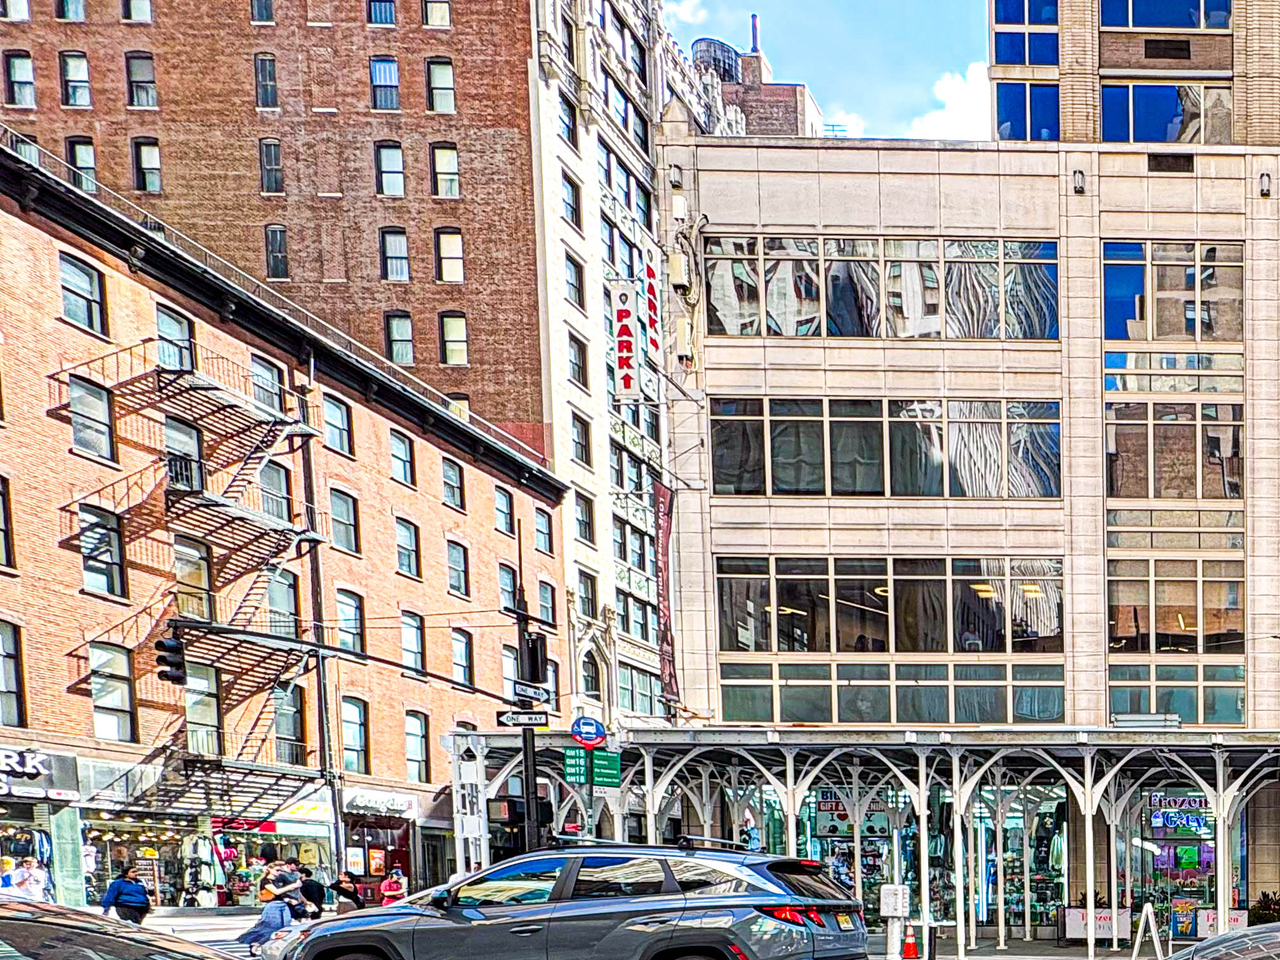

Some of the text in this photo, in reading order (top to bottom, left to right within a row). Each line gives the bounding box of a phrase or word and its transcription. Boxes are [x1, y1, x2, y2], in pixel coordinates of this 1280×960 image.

[616, 308, 635, 370] PARK
[506, 715, 520, 723] ONE
[820, 801, 837, 811] GIFT
